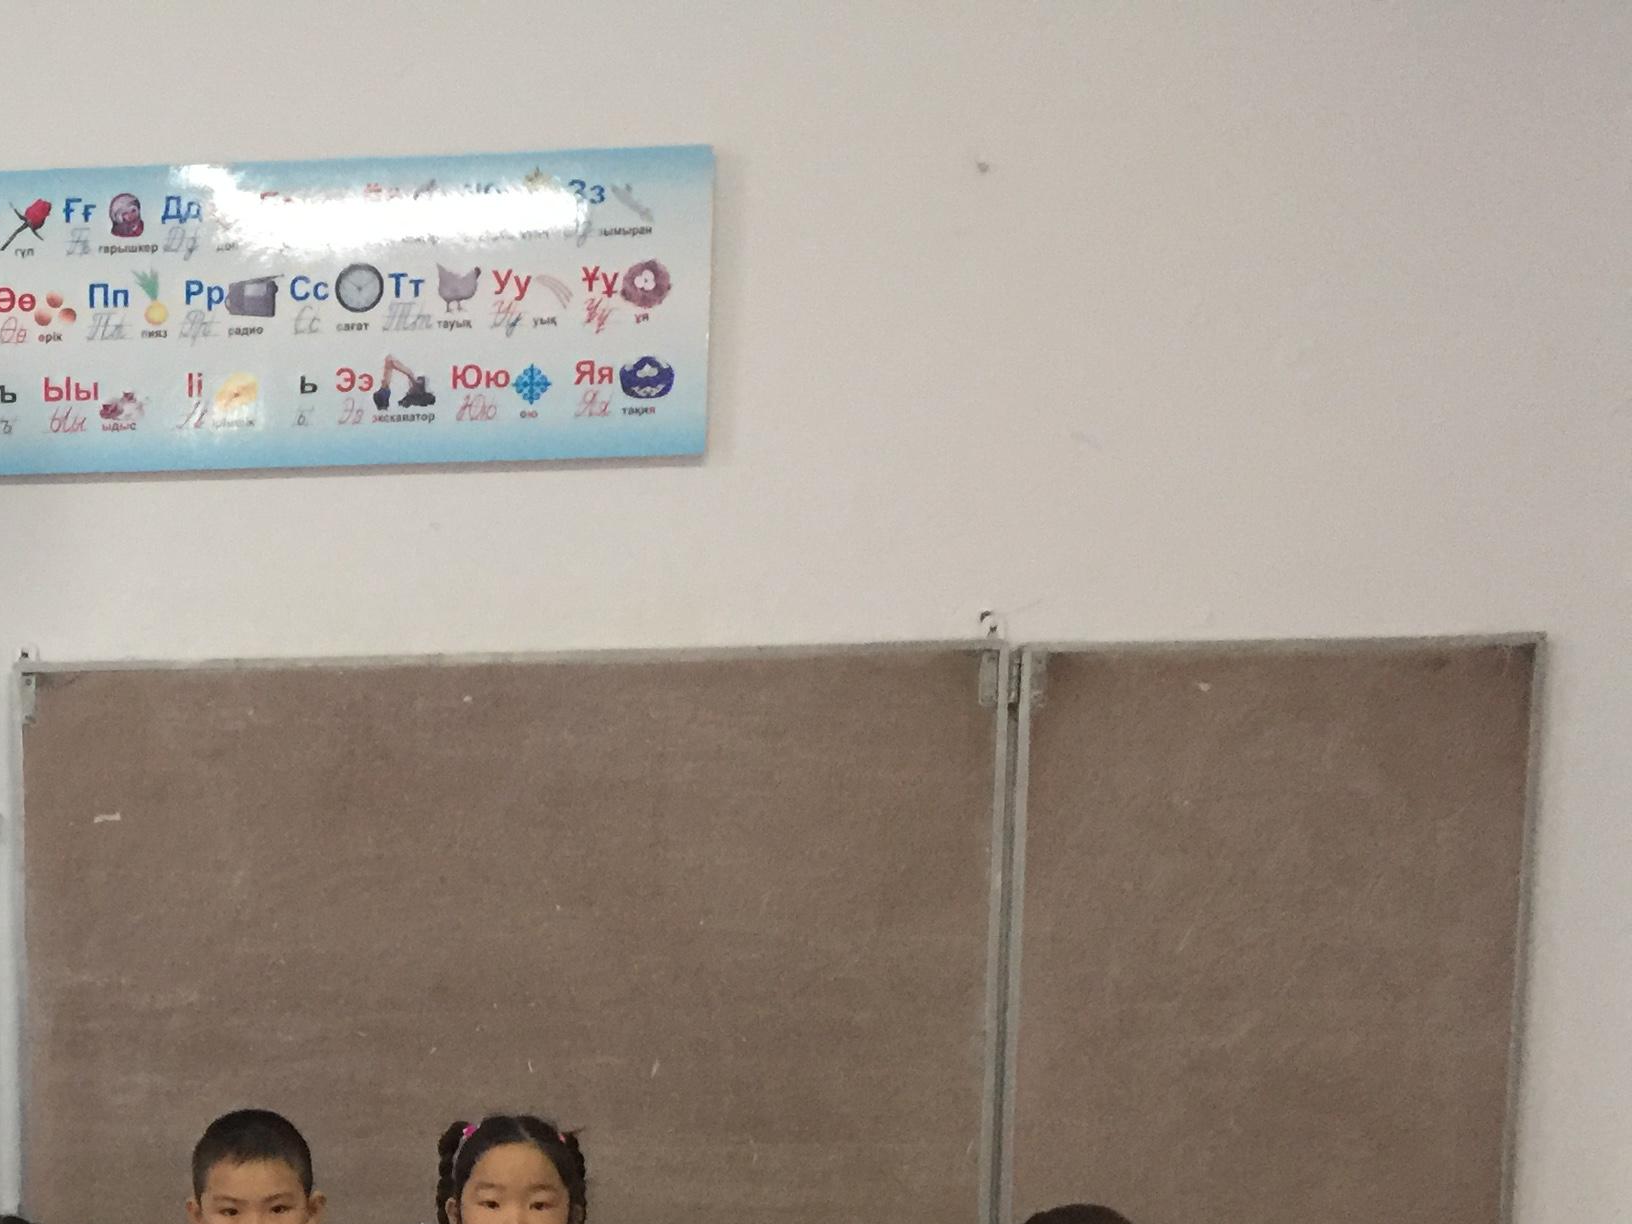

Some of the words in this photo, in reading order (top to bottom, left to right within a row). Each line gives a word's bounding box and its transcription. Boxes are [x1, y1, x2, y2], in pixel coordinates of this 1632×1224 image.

[62, 198, 97, 224] Ғғ
[88, 282, 130, 310] Пп
[184, 278, 226, 312] Рр
[289, 275, 330, 303] Сс
[387, 272, 425, 299] Тт
[491, 267, 532, 302] Уу
[43, 376, 99, 403] Ыы
[335, 367, 375, 394] Ээ
[451, 364, 512, 391] Юю
[573, 359, 616, 387] Яя
